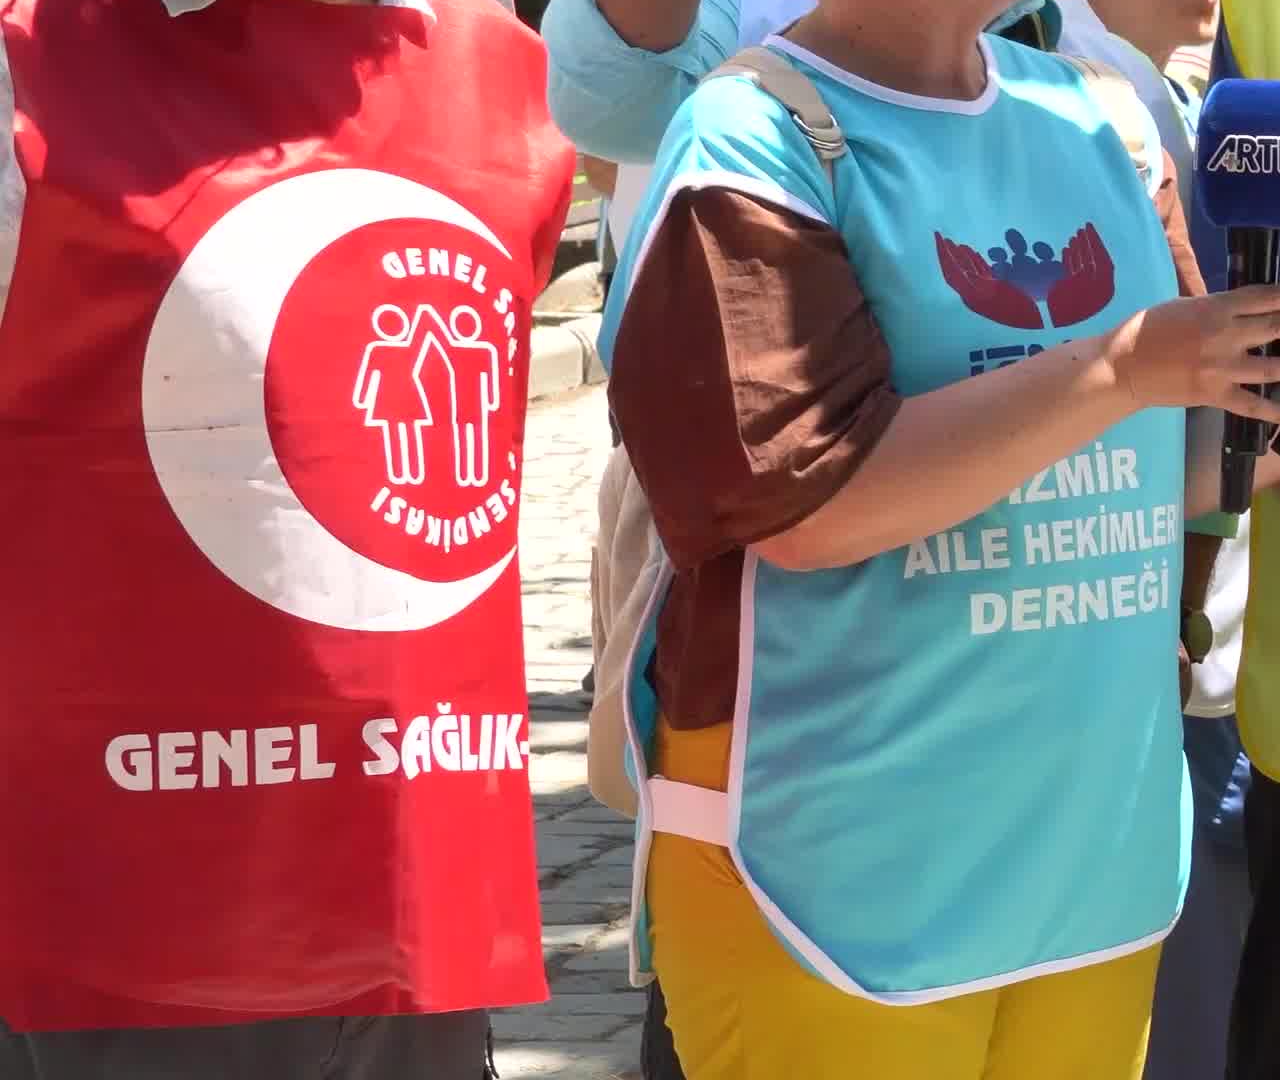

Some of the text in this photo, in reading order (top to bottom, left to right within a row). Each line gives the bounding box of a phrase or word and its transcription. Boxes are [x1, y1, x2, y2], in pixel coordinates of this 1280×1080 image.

[381, 247, 487, 294] GENEL
[370, 480, 516, 554] SENDİKASI
[970, 557, 1169, 636] DERNEĞİ
[104, 723, 337, 793] GENEL
